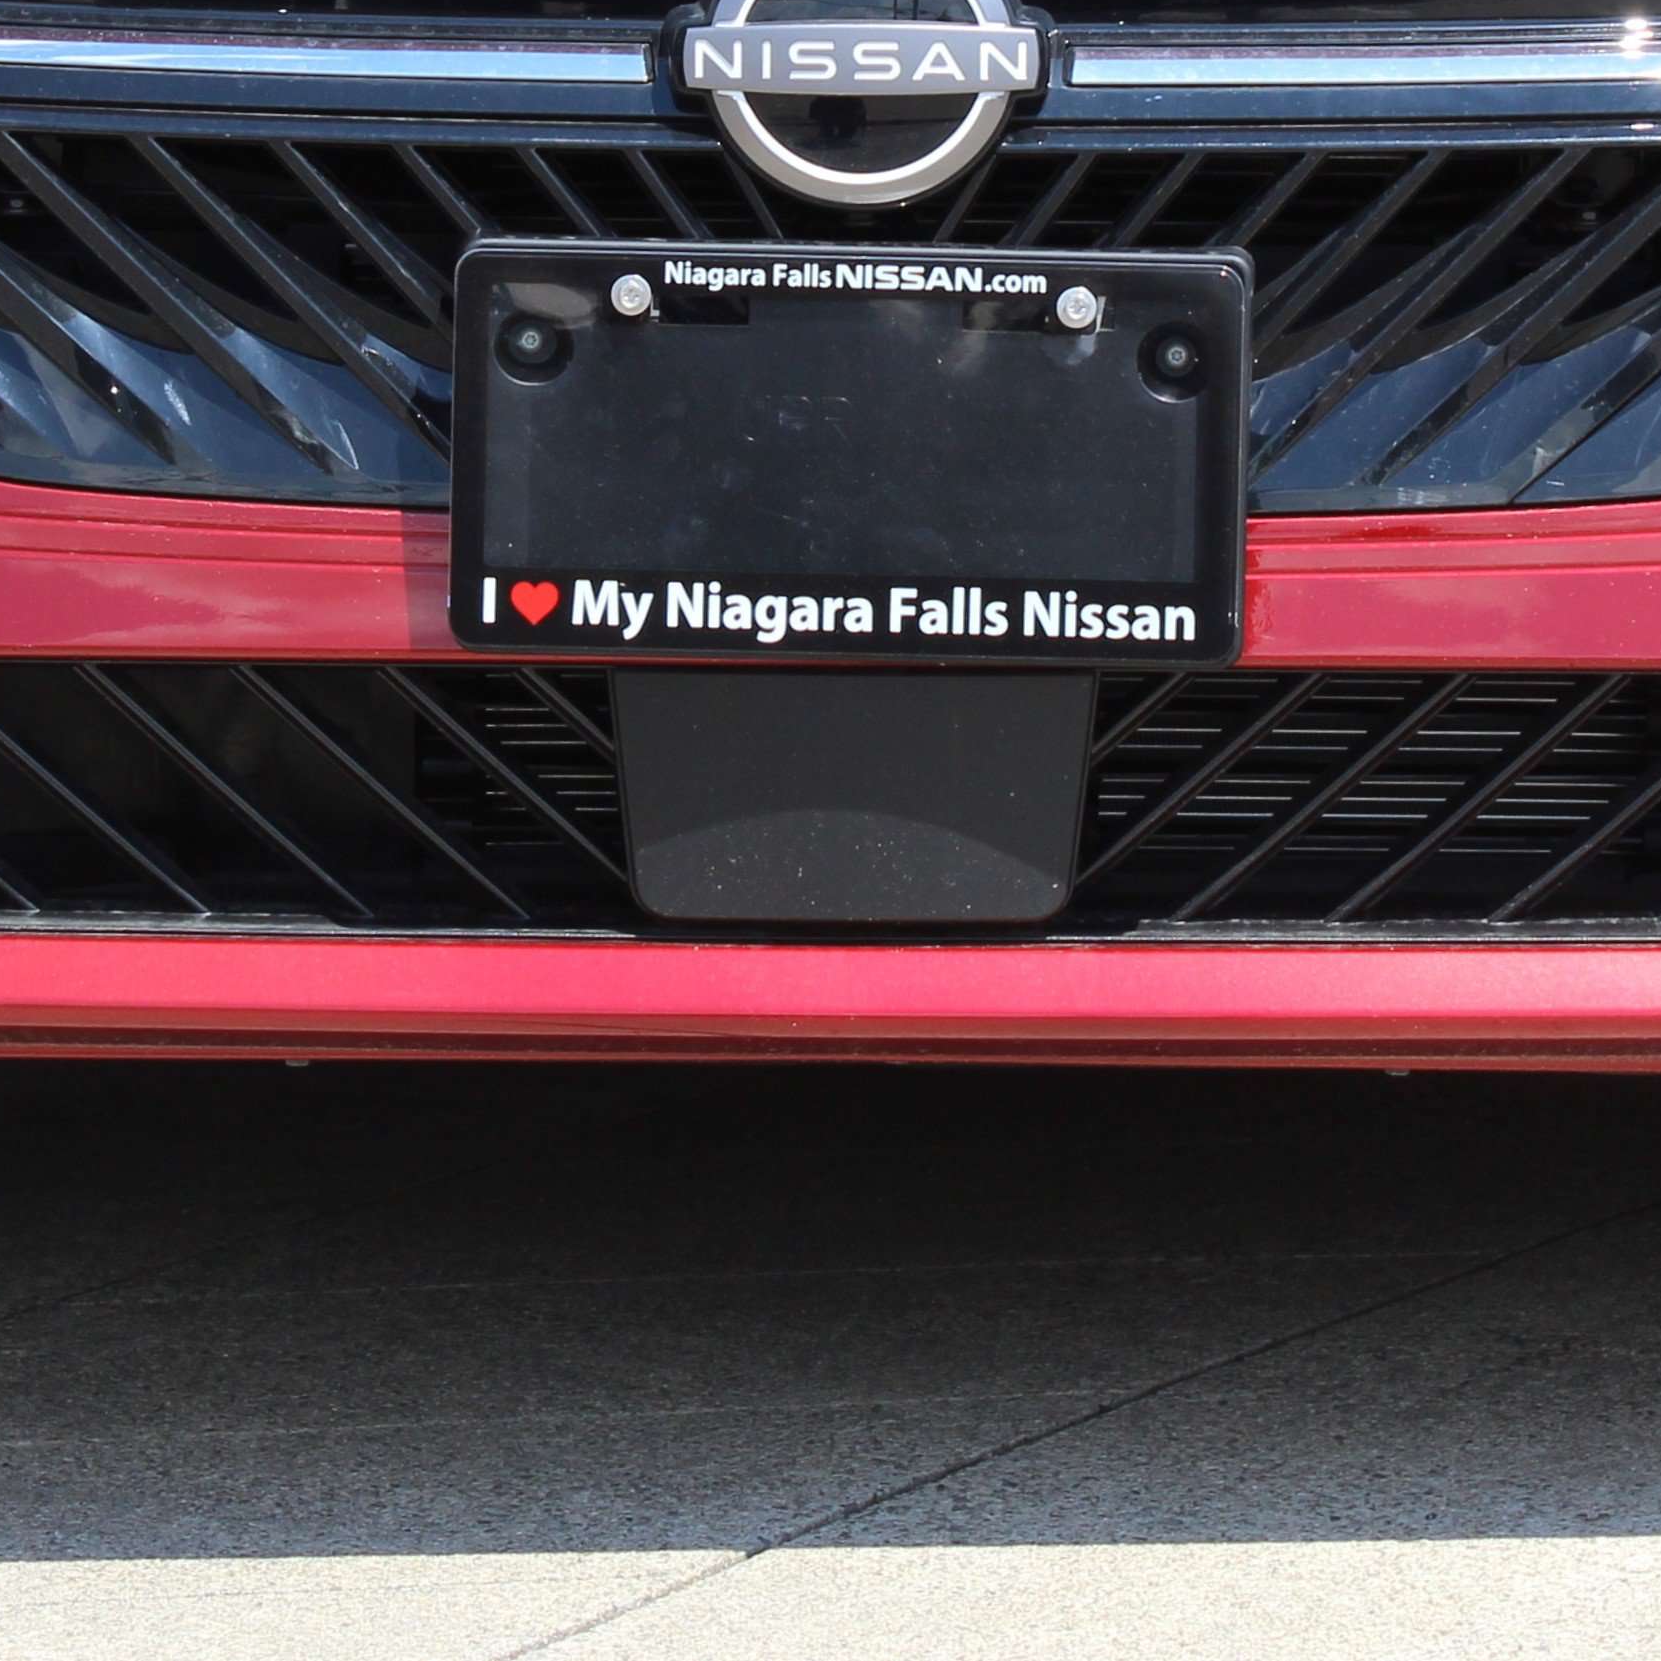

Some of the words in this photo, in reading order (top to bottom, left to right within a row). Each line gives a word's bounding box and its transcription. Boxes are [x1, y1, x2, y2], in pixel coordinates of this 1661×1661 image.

[694, 39, 1027, 81] NISSAN
[664, 261, 766, 291] Niagara
[773, 263, 832, 288] Falls
[482, 576, 497, 624] I
[571, 578, 654, 641] My
[666, 580, 873, 644] Niagara
[889, 586, 1009, 636] Falls
[1023, 589, 1196, 641] Nissan
